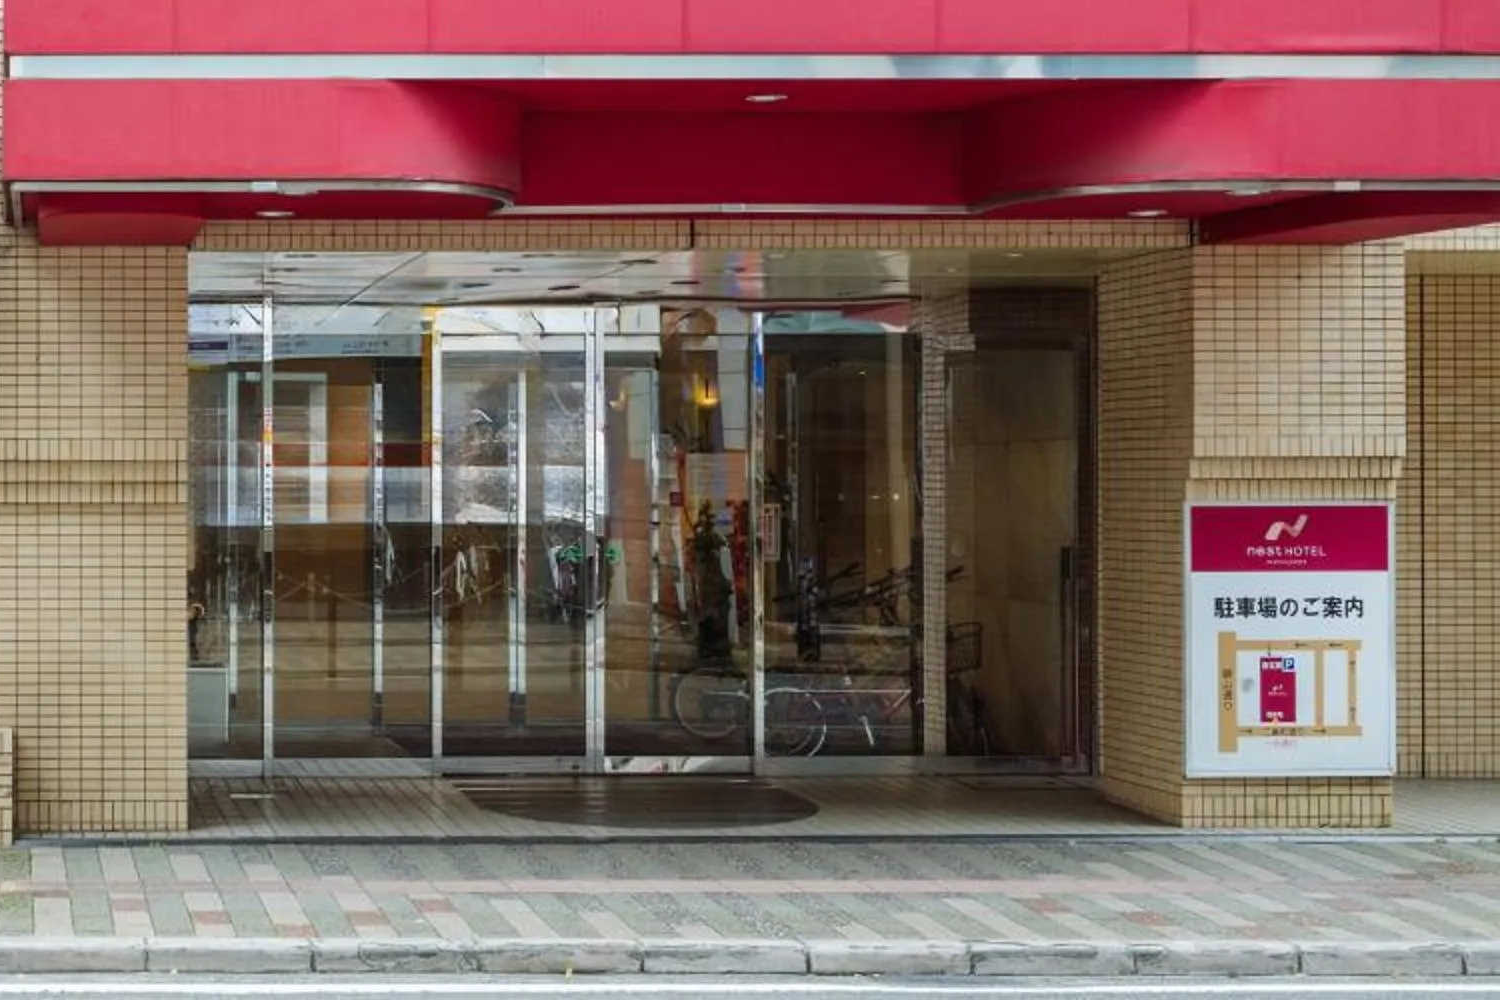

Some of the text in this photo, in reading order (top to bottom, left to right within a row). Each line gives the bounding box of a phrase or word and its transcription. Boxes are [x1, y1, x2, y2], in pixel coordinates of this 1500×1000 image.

[1246, 545, 1327, 557] nest HOTEL
[1213, 596, 1364, 619] 駐車場のご案内
